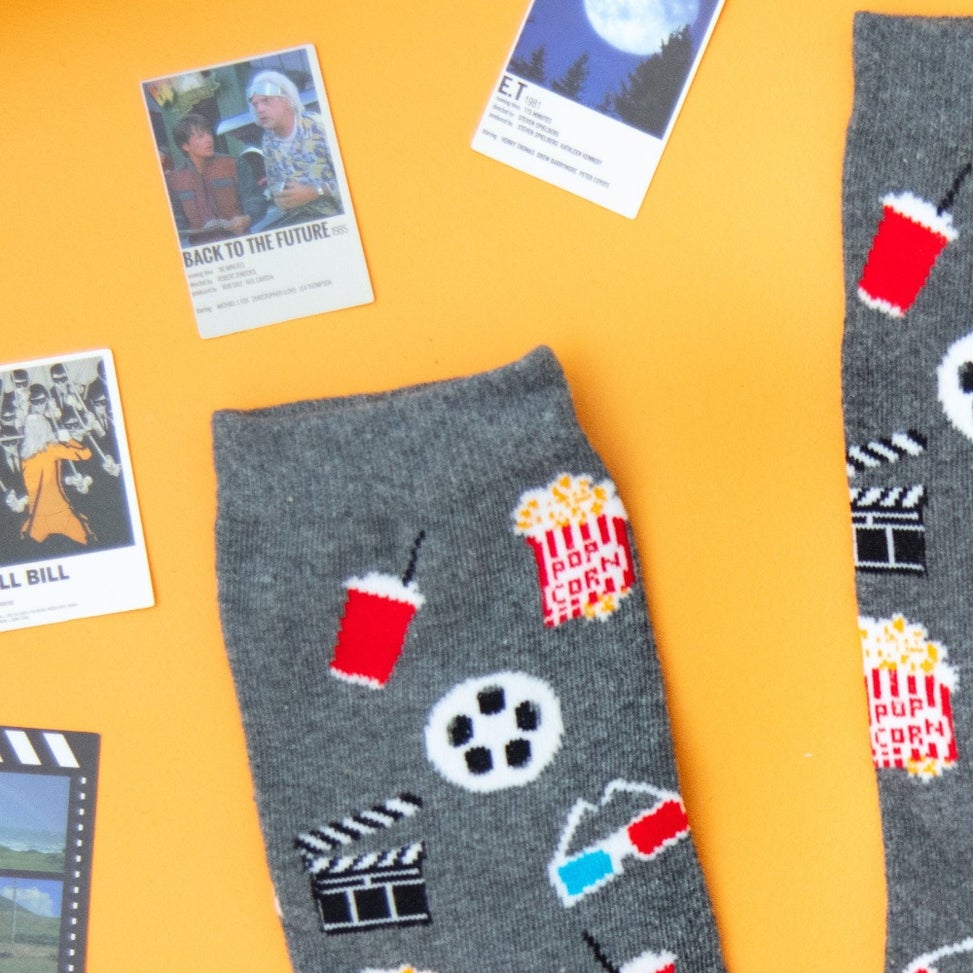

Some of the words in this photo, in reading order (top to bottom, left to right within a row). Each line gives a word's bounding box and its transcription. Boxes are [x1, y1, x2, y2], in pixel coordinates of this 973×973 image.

[497, 75, 528, 101] E.T
[182, 245, 224, 269] BACK
[225, 240, 245, 259] TO
[247, 234, 274, 254] THE
[275, 221, 331, 248] FUTURE
[26, 565, 70, 586] BILL
[552, 541, 599, 580] POP
[552, 552, 621, 604] CORN
[874, 718, 945, 748] CORN
